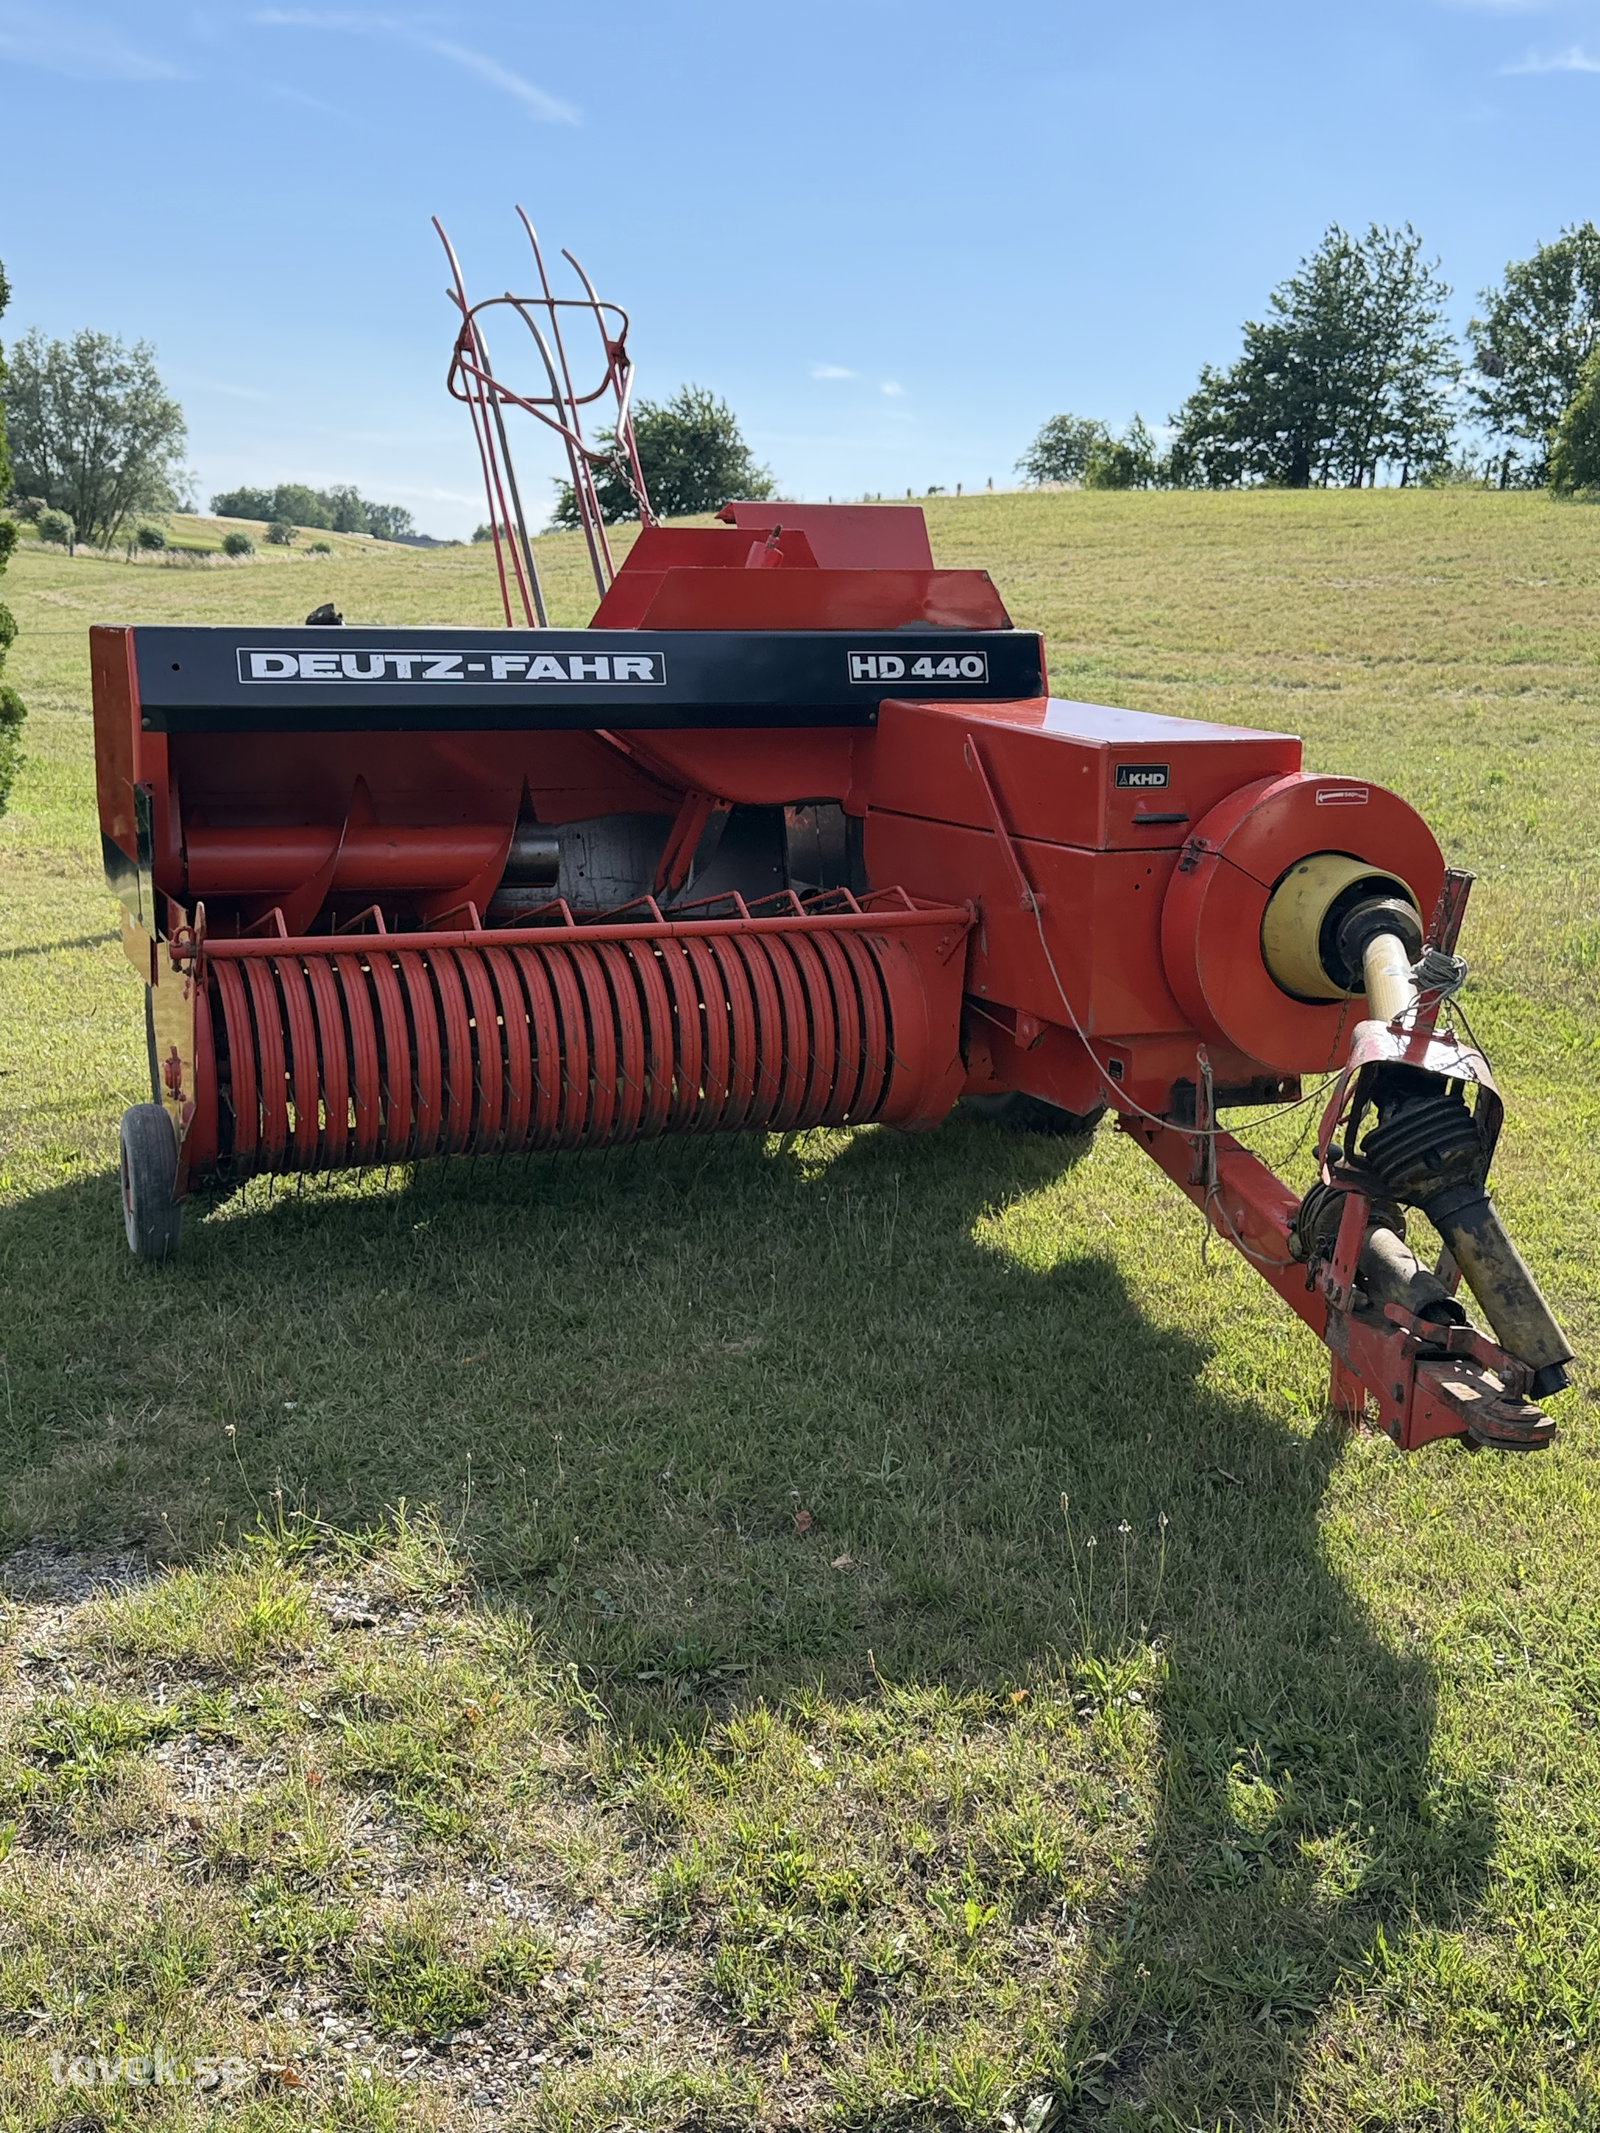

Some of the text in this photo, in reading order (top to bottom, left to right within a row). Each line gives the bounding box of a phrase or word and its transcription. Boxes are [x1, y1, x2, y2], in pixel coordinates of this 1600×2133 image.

[250, 653, 655, 680] DEUTZ-FAHR
[851, 655, 984, 679] HD 440
[1128, 773, 1166, 786] KHD
